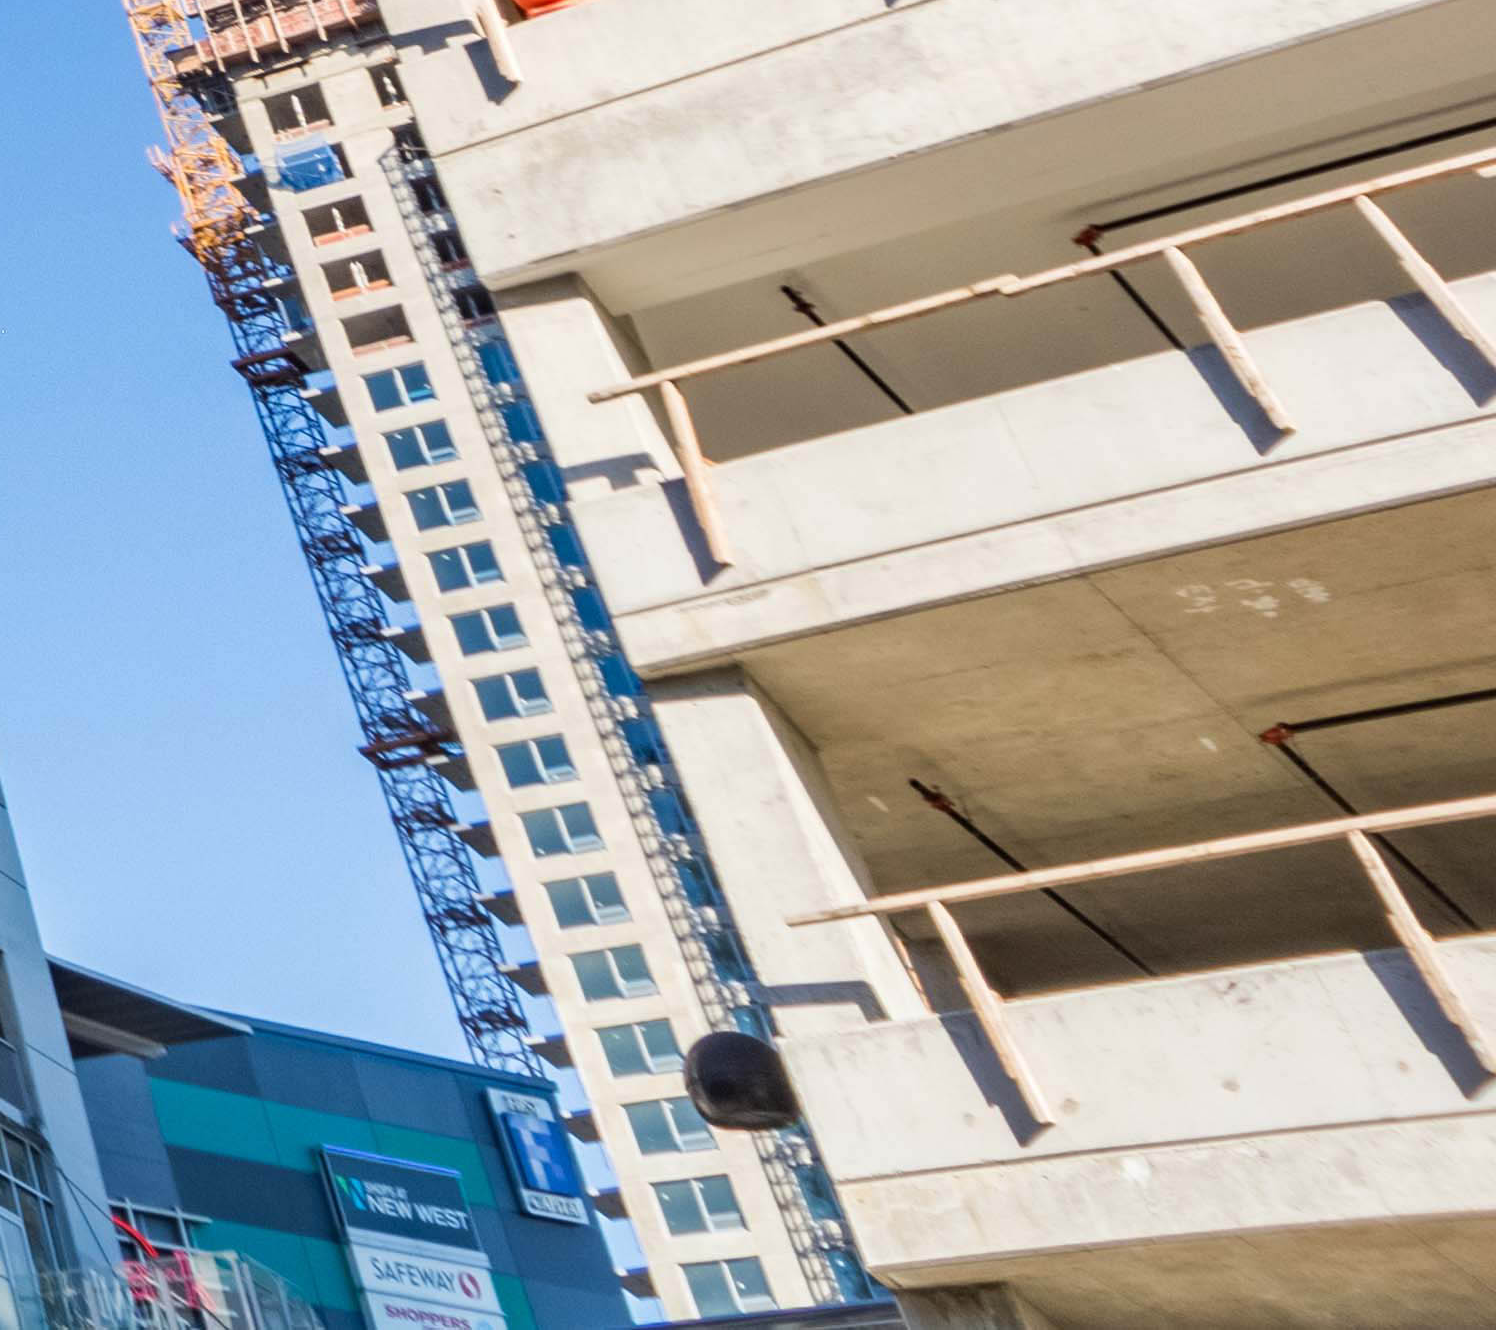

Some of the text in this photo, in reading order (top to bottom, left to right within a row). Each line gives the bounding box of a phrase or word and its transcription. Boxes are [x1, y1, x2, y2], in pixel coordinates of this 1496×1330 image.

[366, 1193, 470, 1231] NEW WEST
[370, 1256, 456, 1293] SAFEWAY
[384, 1303, 472, 1330] SHOPPERS
